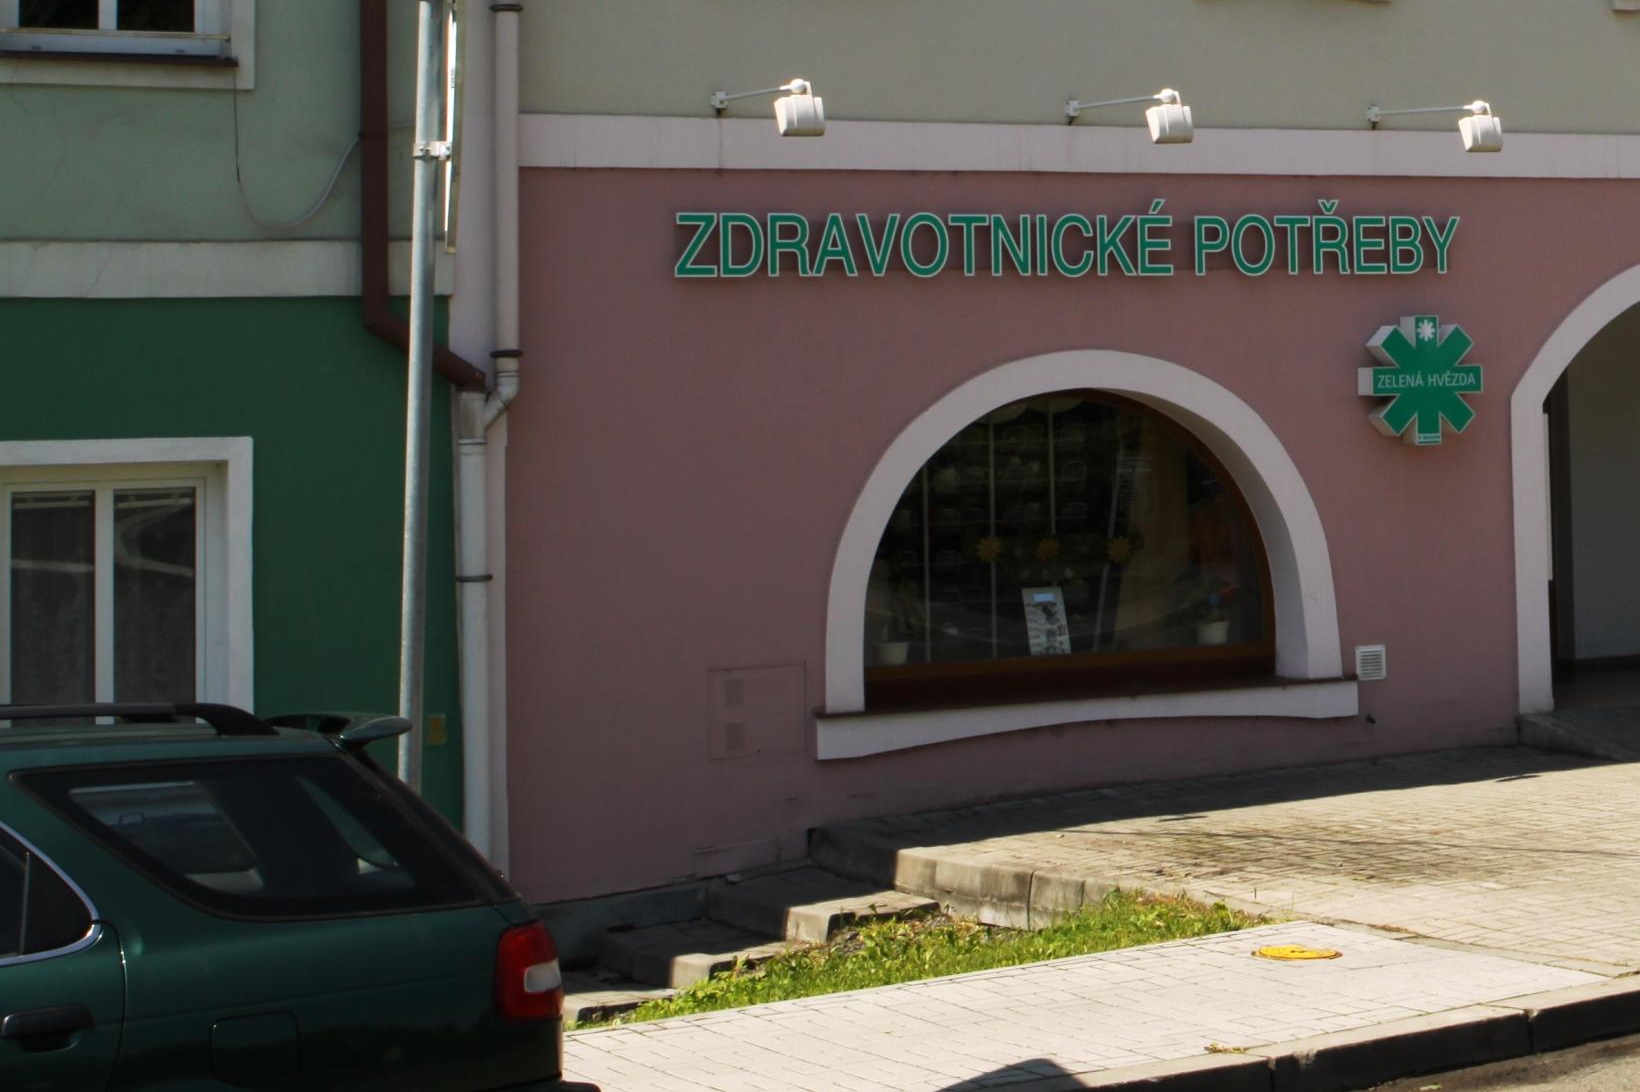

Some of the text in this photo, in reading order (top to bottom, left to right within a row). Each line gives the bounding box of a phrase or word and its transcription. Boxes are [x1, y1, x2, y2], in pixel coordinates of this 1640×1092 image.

[674, 199, 1460, 276] ZDRAVOTNICKÉ POTŘEBY
[1378, 370, 1476, 388] ZELENÁ HVĚZDA
